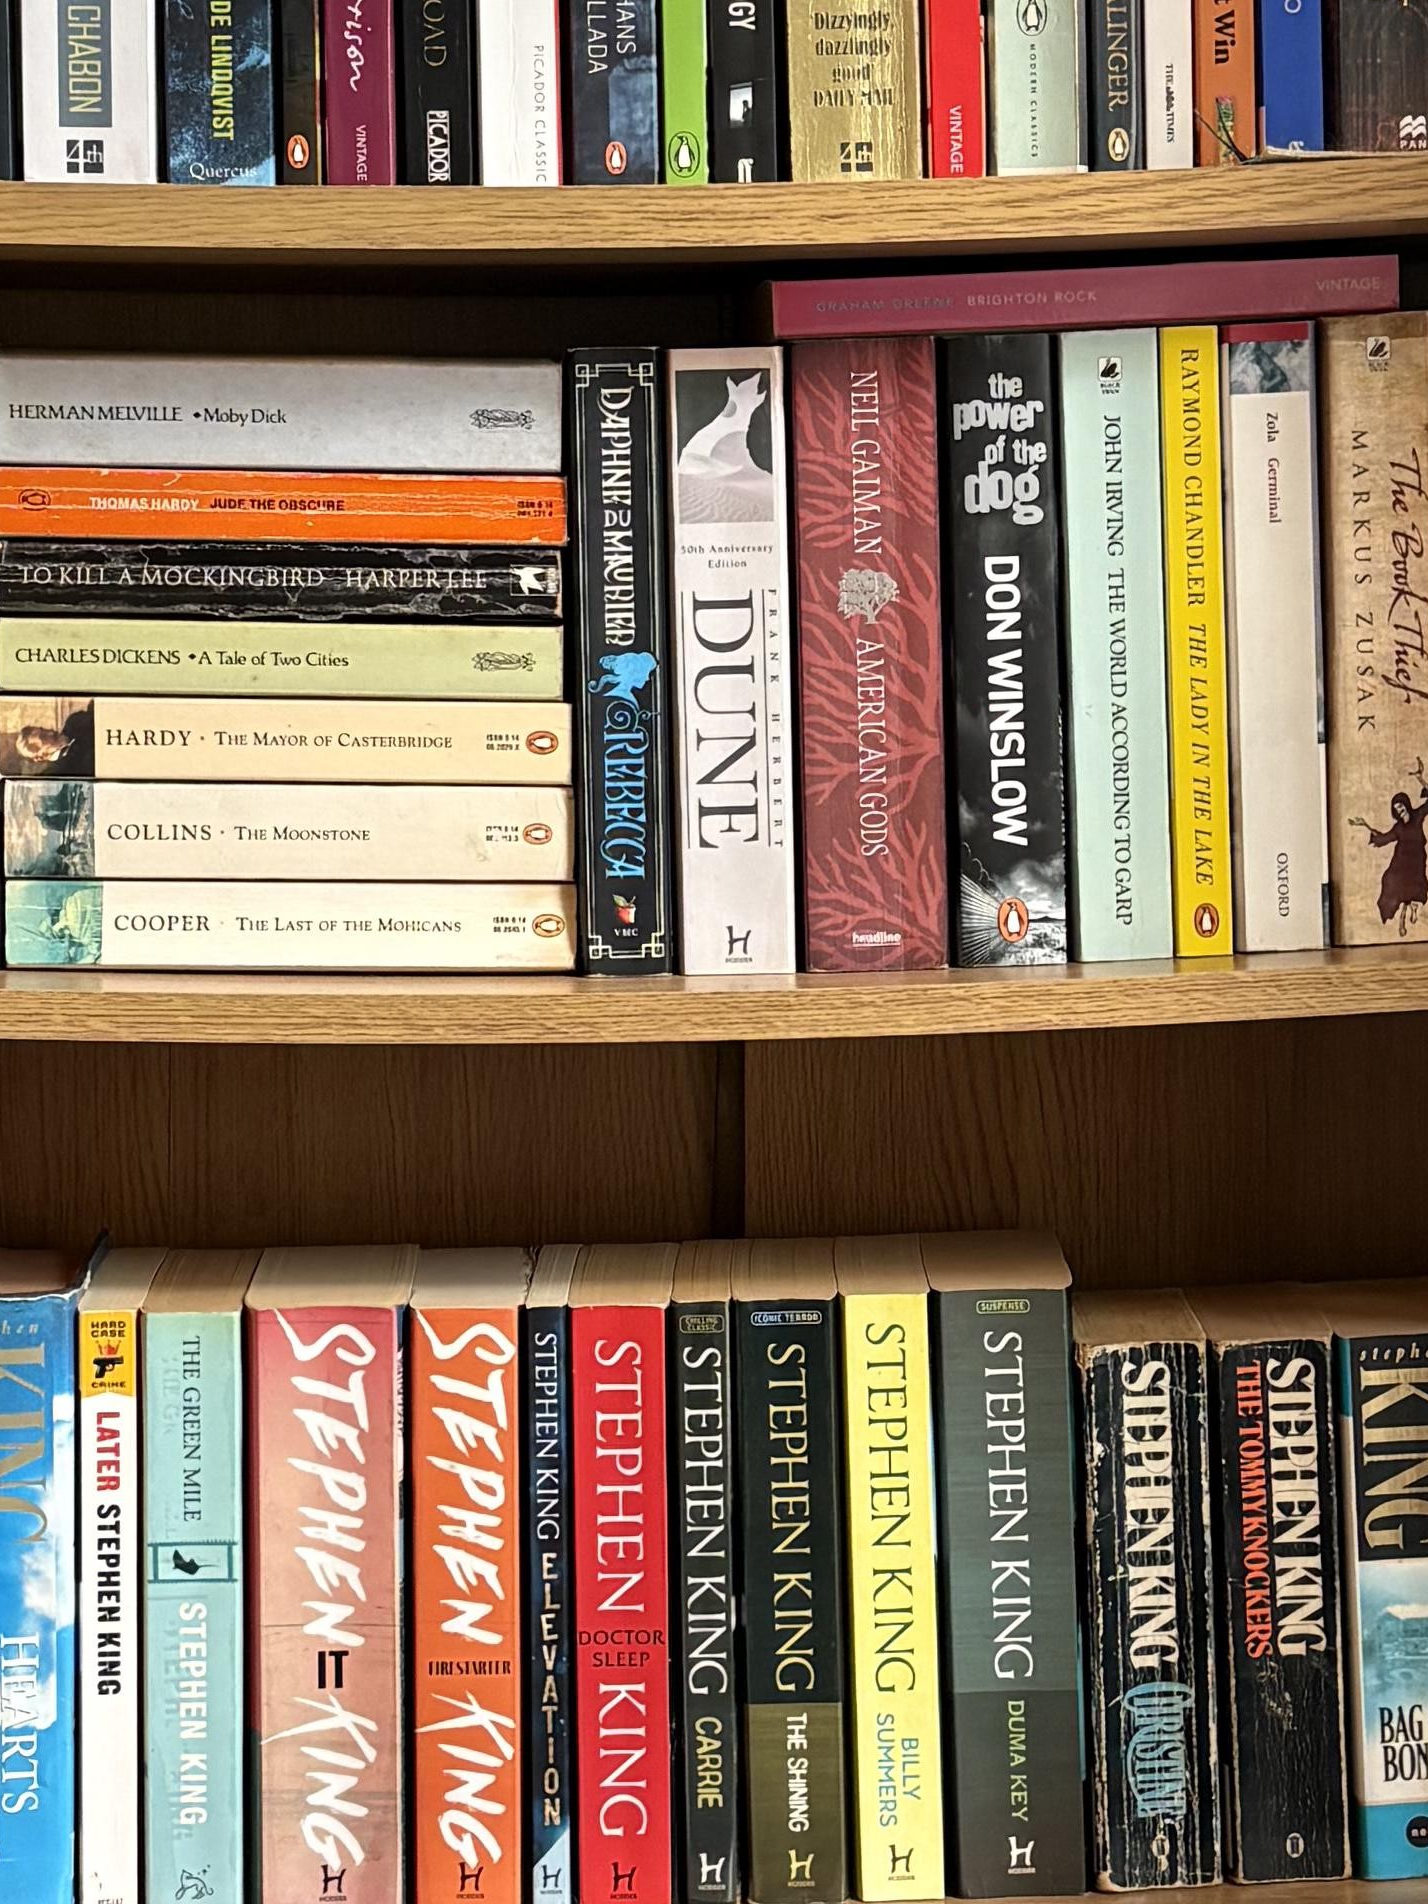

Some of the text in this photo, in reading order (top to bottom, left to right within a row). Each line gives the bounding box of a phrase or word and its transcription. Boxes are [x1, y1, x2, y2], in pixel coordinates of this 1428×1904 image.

[428, 109, 450, 183] PICADOR
[9, 404, 287, 427] HERMAN MELVILLE Moby Dick
[849, 371, 882, 554] NEIL GAIMAN
[1180, 348, 1205, 607] RAYMOND CHANDLER
[692, 591, 759, 849] DUNE
[983, 555, 1029, 847] DON WINSLOW
[105, 728, 191, 747] HARDY
[856, 639, 887, 856] AMERICAN GODS
[107, 823, 211, 841] COLLINS
[1275, 853, 1289, 918] OXFORD
[114, 914, 210, 932] COOPER
[95, 1412, 122, 1696] LATER STEPHEN KING
[317, 1651, 348, 1689] IT
[578, 1629, 665, 1646] DOCTOR
[592, 1650, 650, 1669] SLEEP
[1379, 1707, 1423, 1744] BAG
[693, 1717, 723, 1808] CARRIE
[876, 1713, 898, 1828] SUMMERS
[901, 1736, 920, 1801] BILLY
